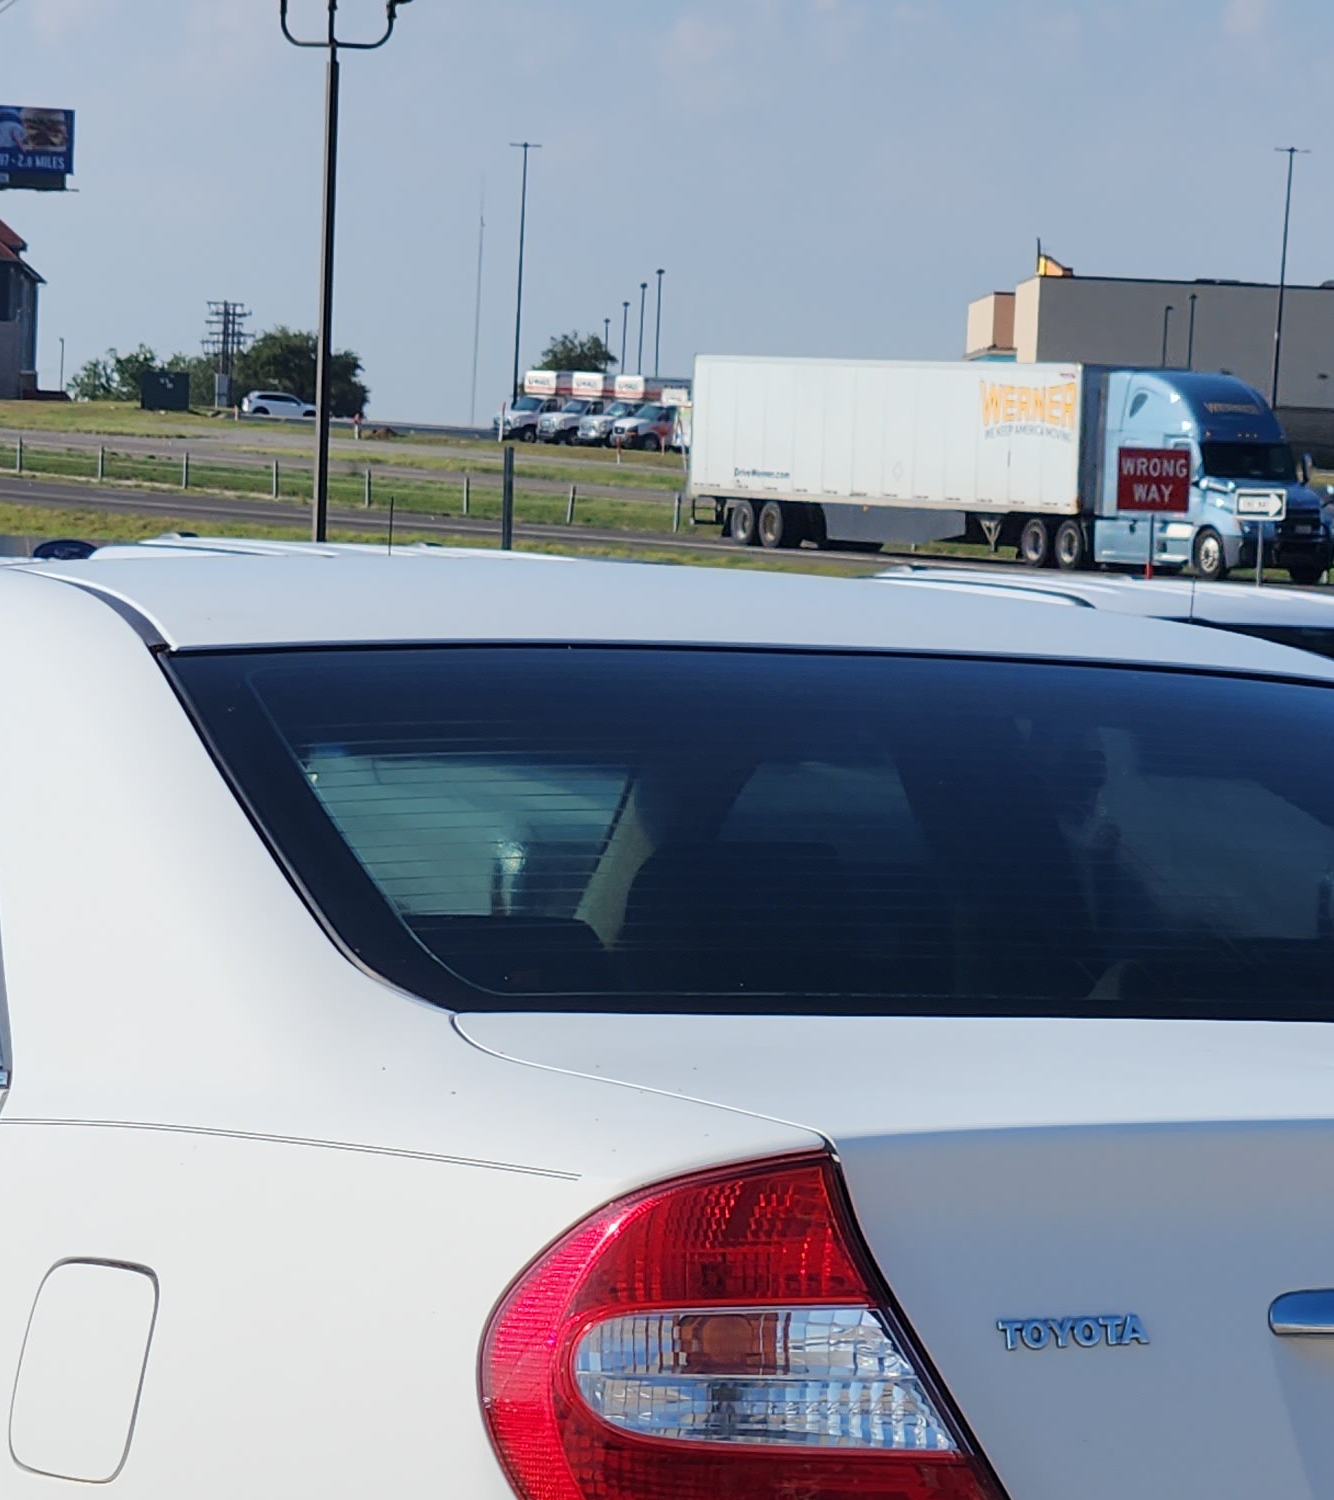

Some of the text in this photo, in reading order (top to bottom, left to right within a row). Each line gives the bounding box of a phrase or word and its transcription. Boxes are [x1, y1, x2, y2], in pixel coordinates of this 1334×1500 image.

[34, 154, 65, 171] MILES
[980, 380, 1077, 430] WERNER
[1120, 457, 1189, 479] WRONG
[1132, 483, 1173, 503] WAY
[996, 1314, 1150, 1351] TOYOTA
